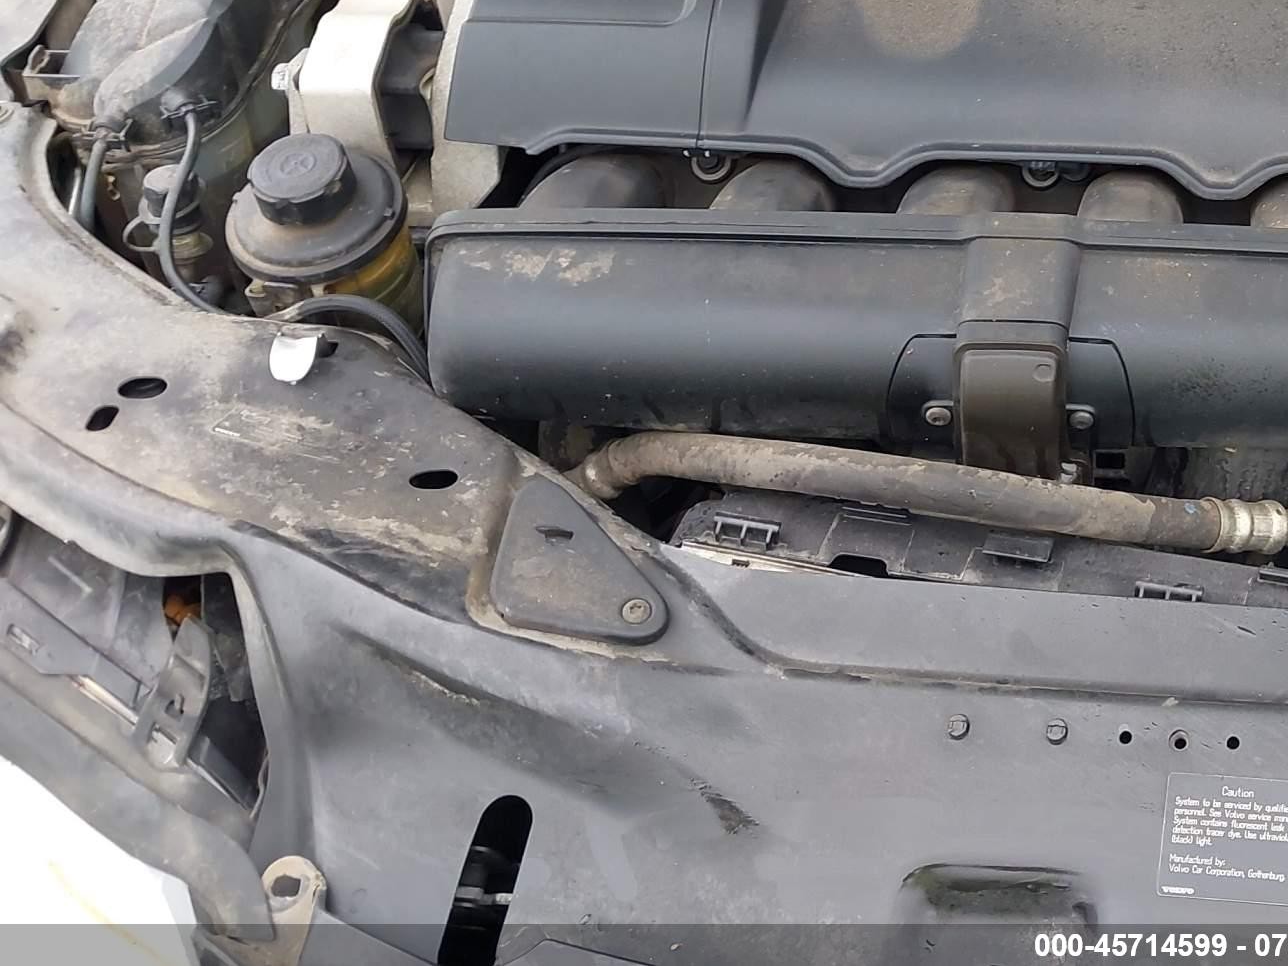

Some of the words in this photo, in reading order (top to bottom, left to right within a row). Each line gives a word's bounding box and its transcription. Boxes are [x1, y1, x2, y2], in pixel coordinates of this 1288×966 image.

[1222, 786, 1254, 797] Caution
[1175, 796, 1199, 806] System
[1203, 798, 1210, 806] to
[1213, 799, 1221, 807] be
[1224, 800, 1251, 810] serviced
[1253, 802, 1262, 811] by
[1174, 808, 1206, 816] personnel.
[1209, 809, 1222, 817] See
[1225, 810, 1245, 819] Volvo
[1248, 813, 1271, 821] service
[1174, 816, 1197, 825] System
[1200, 819, 1227, 827] contains
[1231, 821, 1267, 830] fluorescent
[1271, 823, 1284, 831] leak
[1172, 827, 1203, 835] detection
[1228, 830, 1241, 840] dye.
[1245, 831, 1257, 839] Use
[1172, 835, 1193, 844] (black)
[1196, 837, 1212, 846] light.
[1169, 854, 1212, 864] Manufactured
[1215, 858, 1225, 867] by:
[1169, 864, 1189, 873] Volvo
[1192, 866, 1203, 874] Car
[1206, 866, 1245, 878] Corporation,
